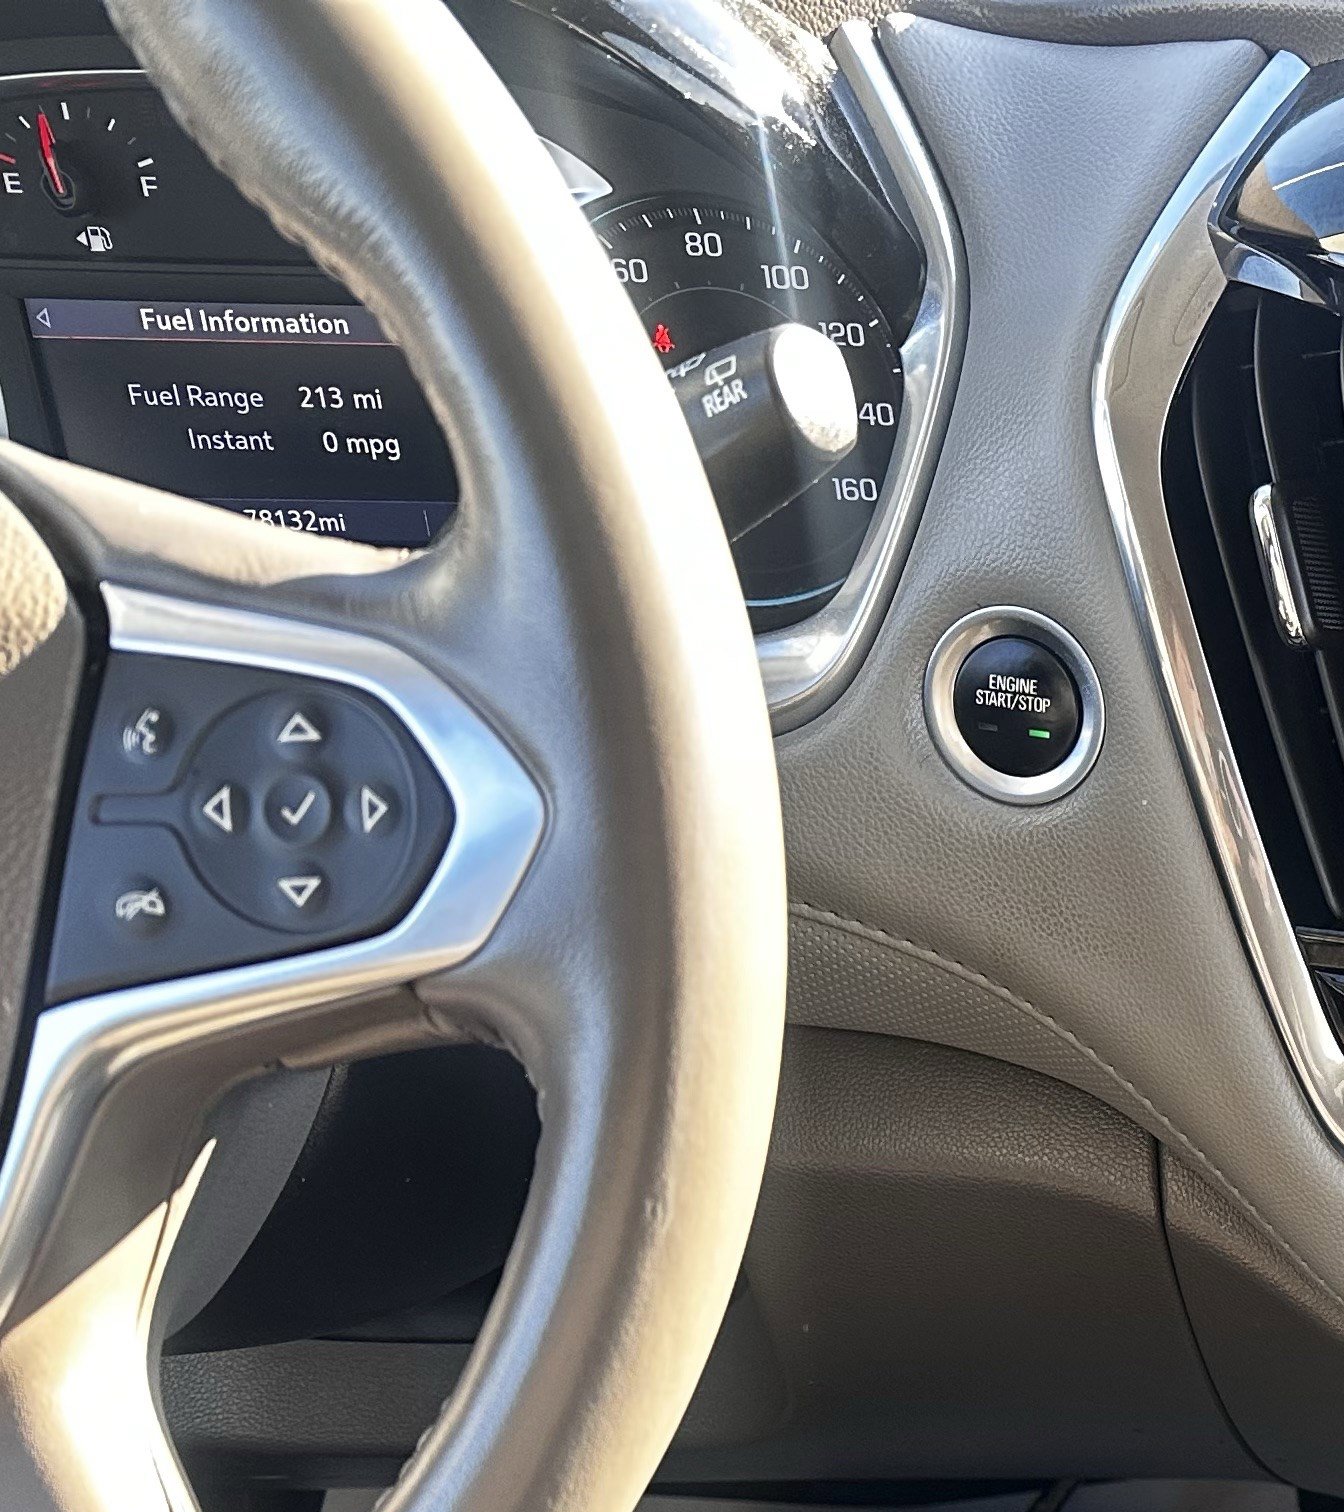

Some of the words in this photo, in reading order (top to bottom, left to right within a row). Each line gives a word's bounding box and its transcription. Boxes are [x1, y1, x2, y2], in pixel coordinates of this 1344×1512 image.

[2, 172, 23, 194] E
[140, 175, 158, 197] F
[684, 232, 723, 257] 80
[761, 264, 809, 290] 100
[140, 308, 194, 332] Fuel
[199, 309, 350, 335] Information
[127, 383, 181, 407] Fuel
[187, 385, 264, 414] Range
[298, 386, 344, 409] 213
[353, 389, 383, 409] mi
[702, 379, 748, 417] REAR
[858, 402, 895, 426] 40
[188, 428, 275, 451] Instant
[322, 432, 338, 453] 0
[346, 436, 401, 461] mpg
[832, 478, 878, 501] 160
[989, 674, 1038, 695] ENGINE
[976, 689, 1050, 713] START/STOP
